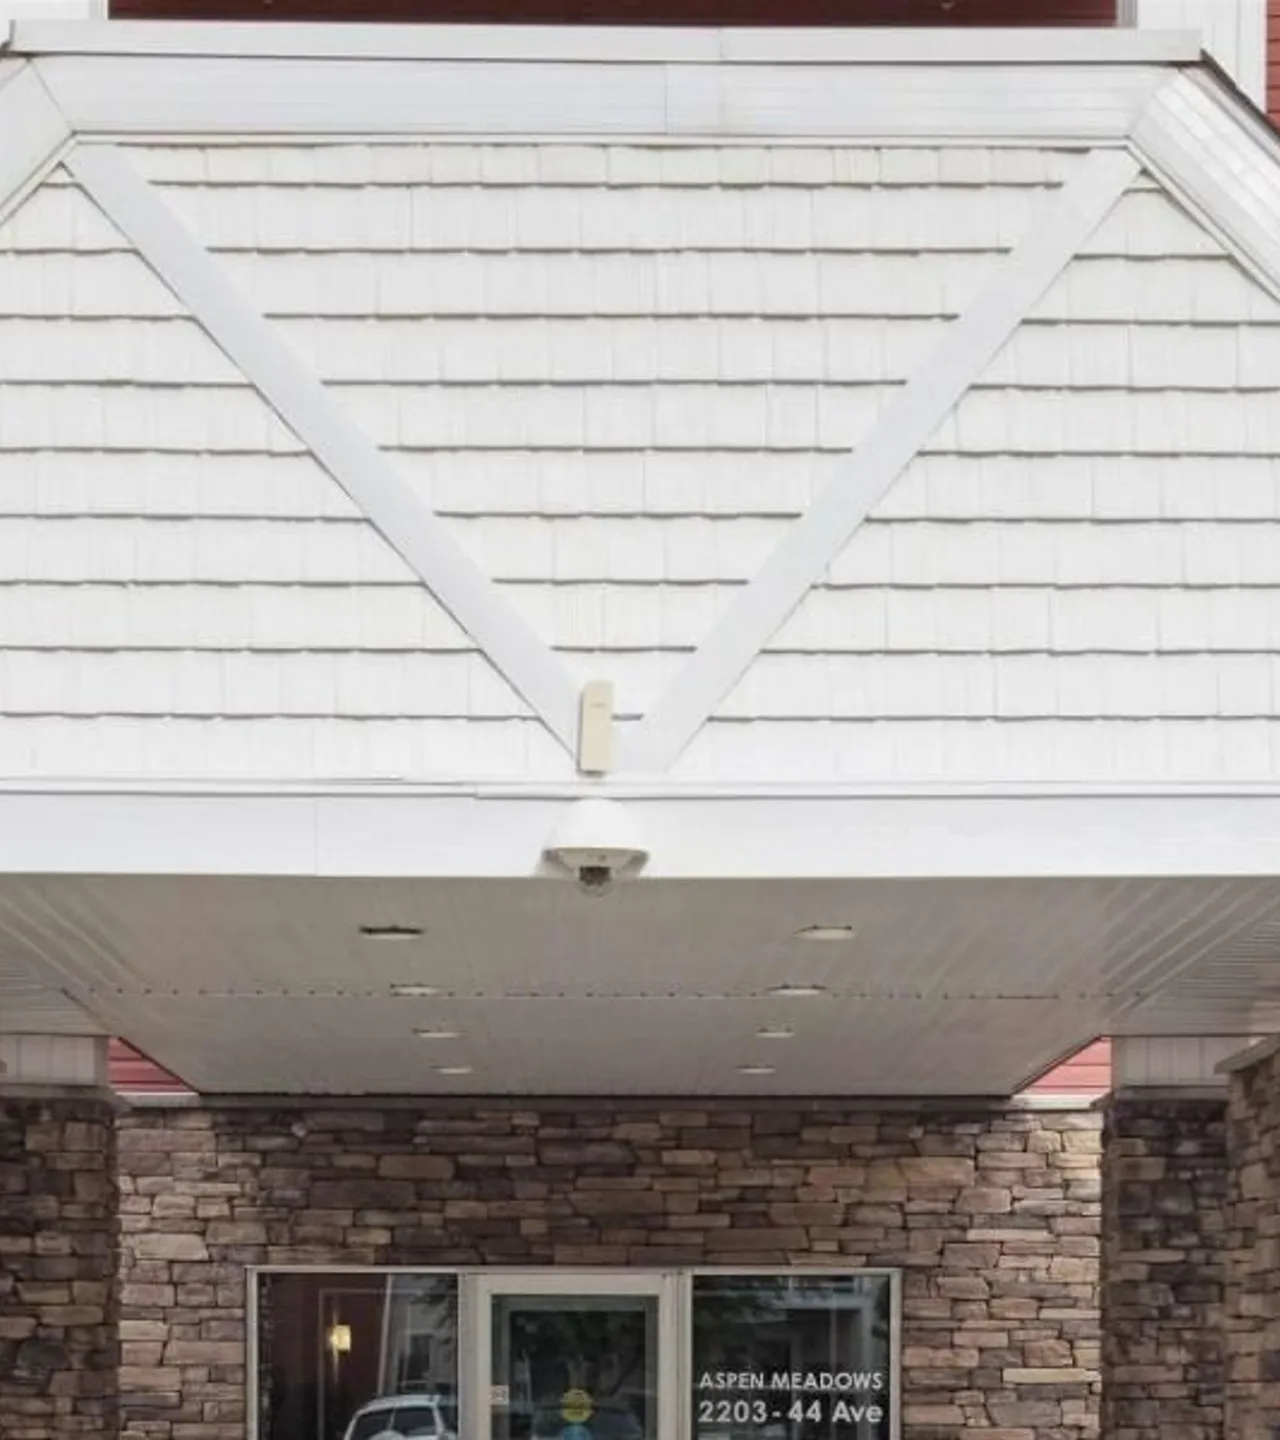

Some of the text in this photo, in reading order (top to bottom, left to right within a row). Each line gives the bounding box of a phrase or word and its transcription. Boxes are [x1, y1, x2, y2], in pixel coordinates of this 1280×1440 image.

[699, 1372, 884, 1389] ASPEN MEADOWS
[697, 1401, 767, 1423] 2203
[788, 1400, 822, 1423] 44
[831, 1401, 883, 1423] Ave
